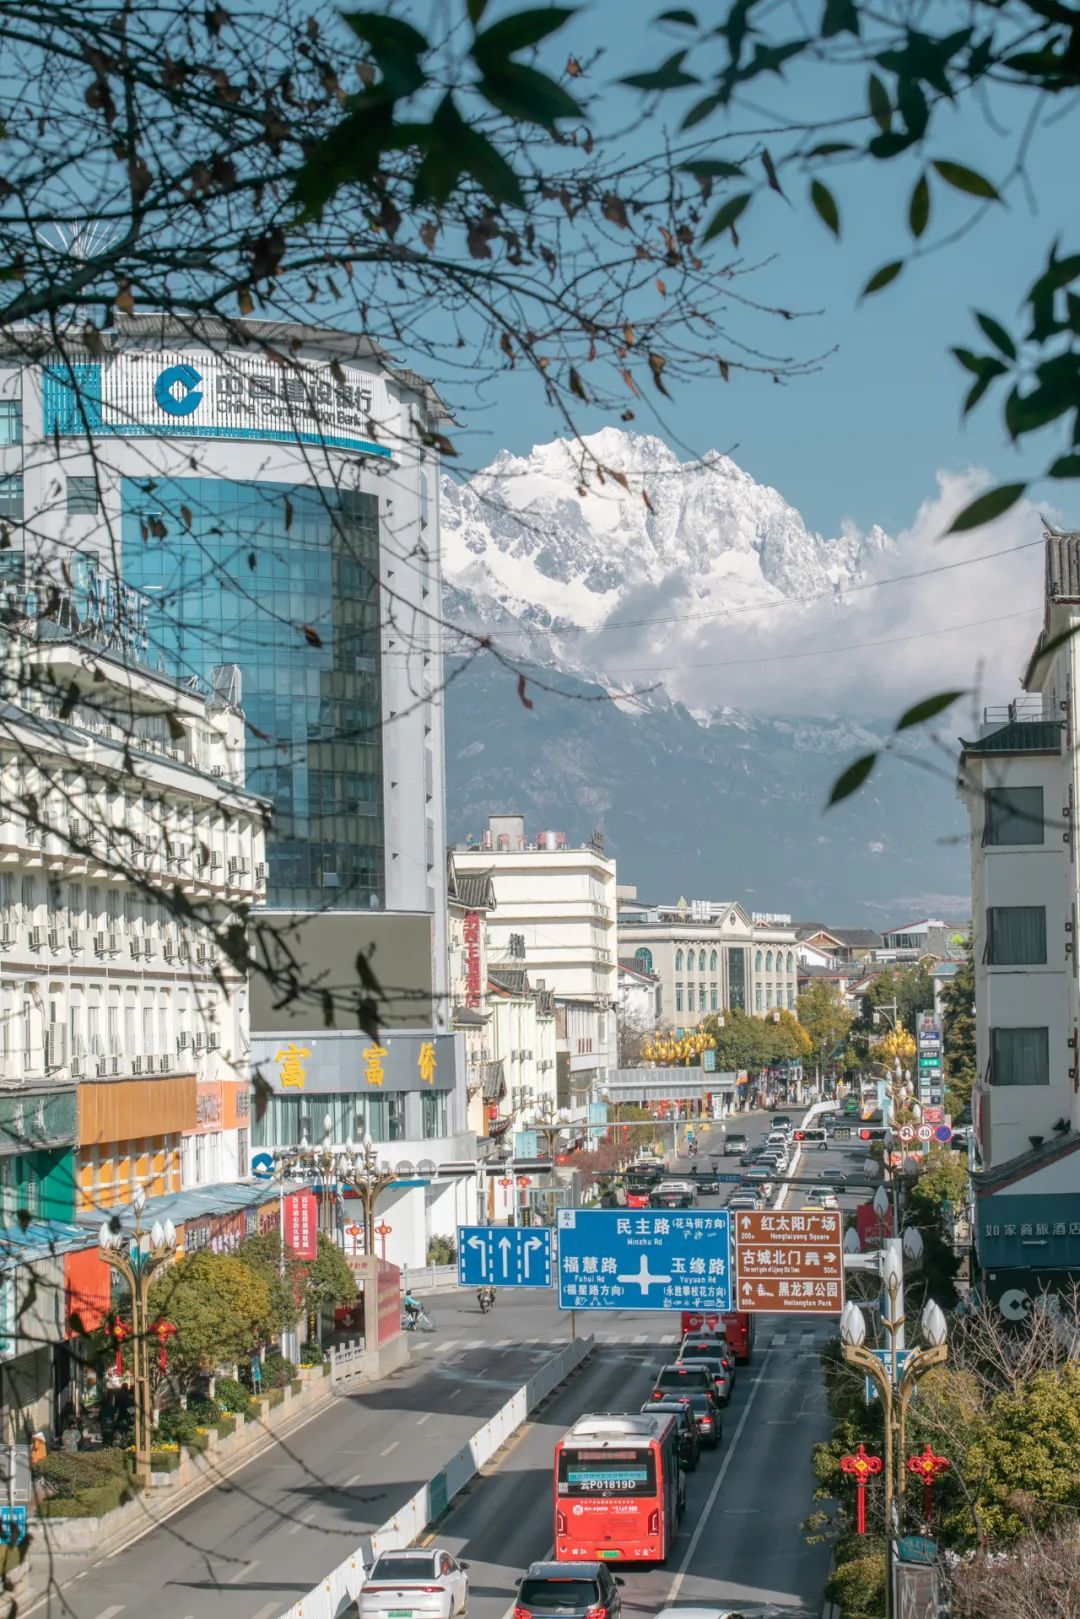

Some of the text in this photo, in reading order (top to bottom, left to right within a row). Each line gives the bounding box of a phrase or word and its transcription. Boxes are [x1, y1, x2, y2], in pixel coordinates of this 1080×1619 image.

[216, 374, 372, 413] 中国建设银行
[337, 411, 361, 427] Bank
[920, 1129, 930, 1137] 40
[563, 1212, 571, 1220] 北
[761, 1216, 836, 1231] 红太阳广场
[617, 1218, 670, 1235] 民主路
[985, 1222, 1080, 1237] 如家商旅酒店
[627, 1238, 663, 1246] Minzhu Rd
[809, 1233, 830, 1241] Square
[742, 1249, 801, 1265] 古城北门
[563, 1256, 617, 1274] 福慧路
[670, 1257, 725, 1275] 玉缘路
[574, 1275, 605, 1283] Fuhui Rd
[680, 1276, 717, 1284] Yuyuan Rd
[779, 1281, 838, 1297] 黑龙潭公园
[581, 1480, 636, 1490] 云P01819D
